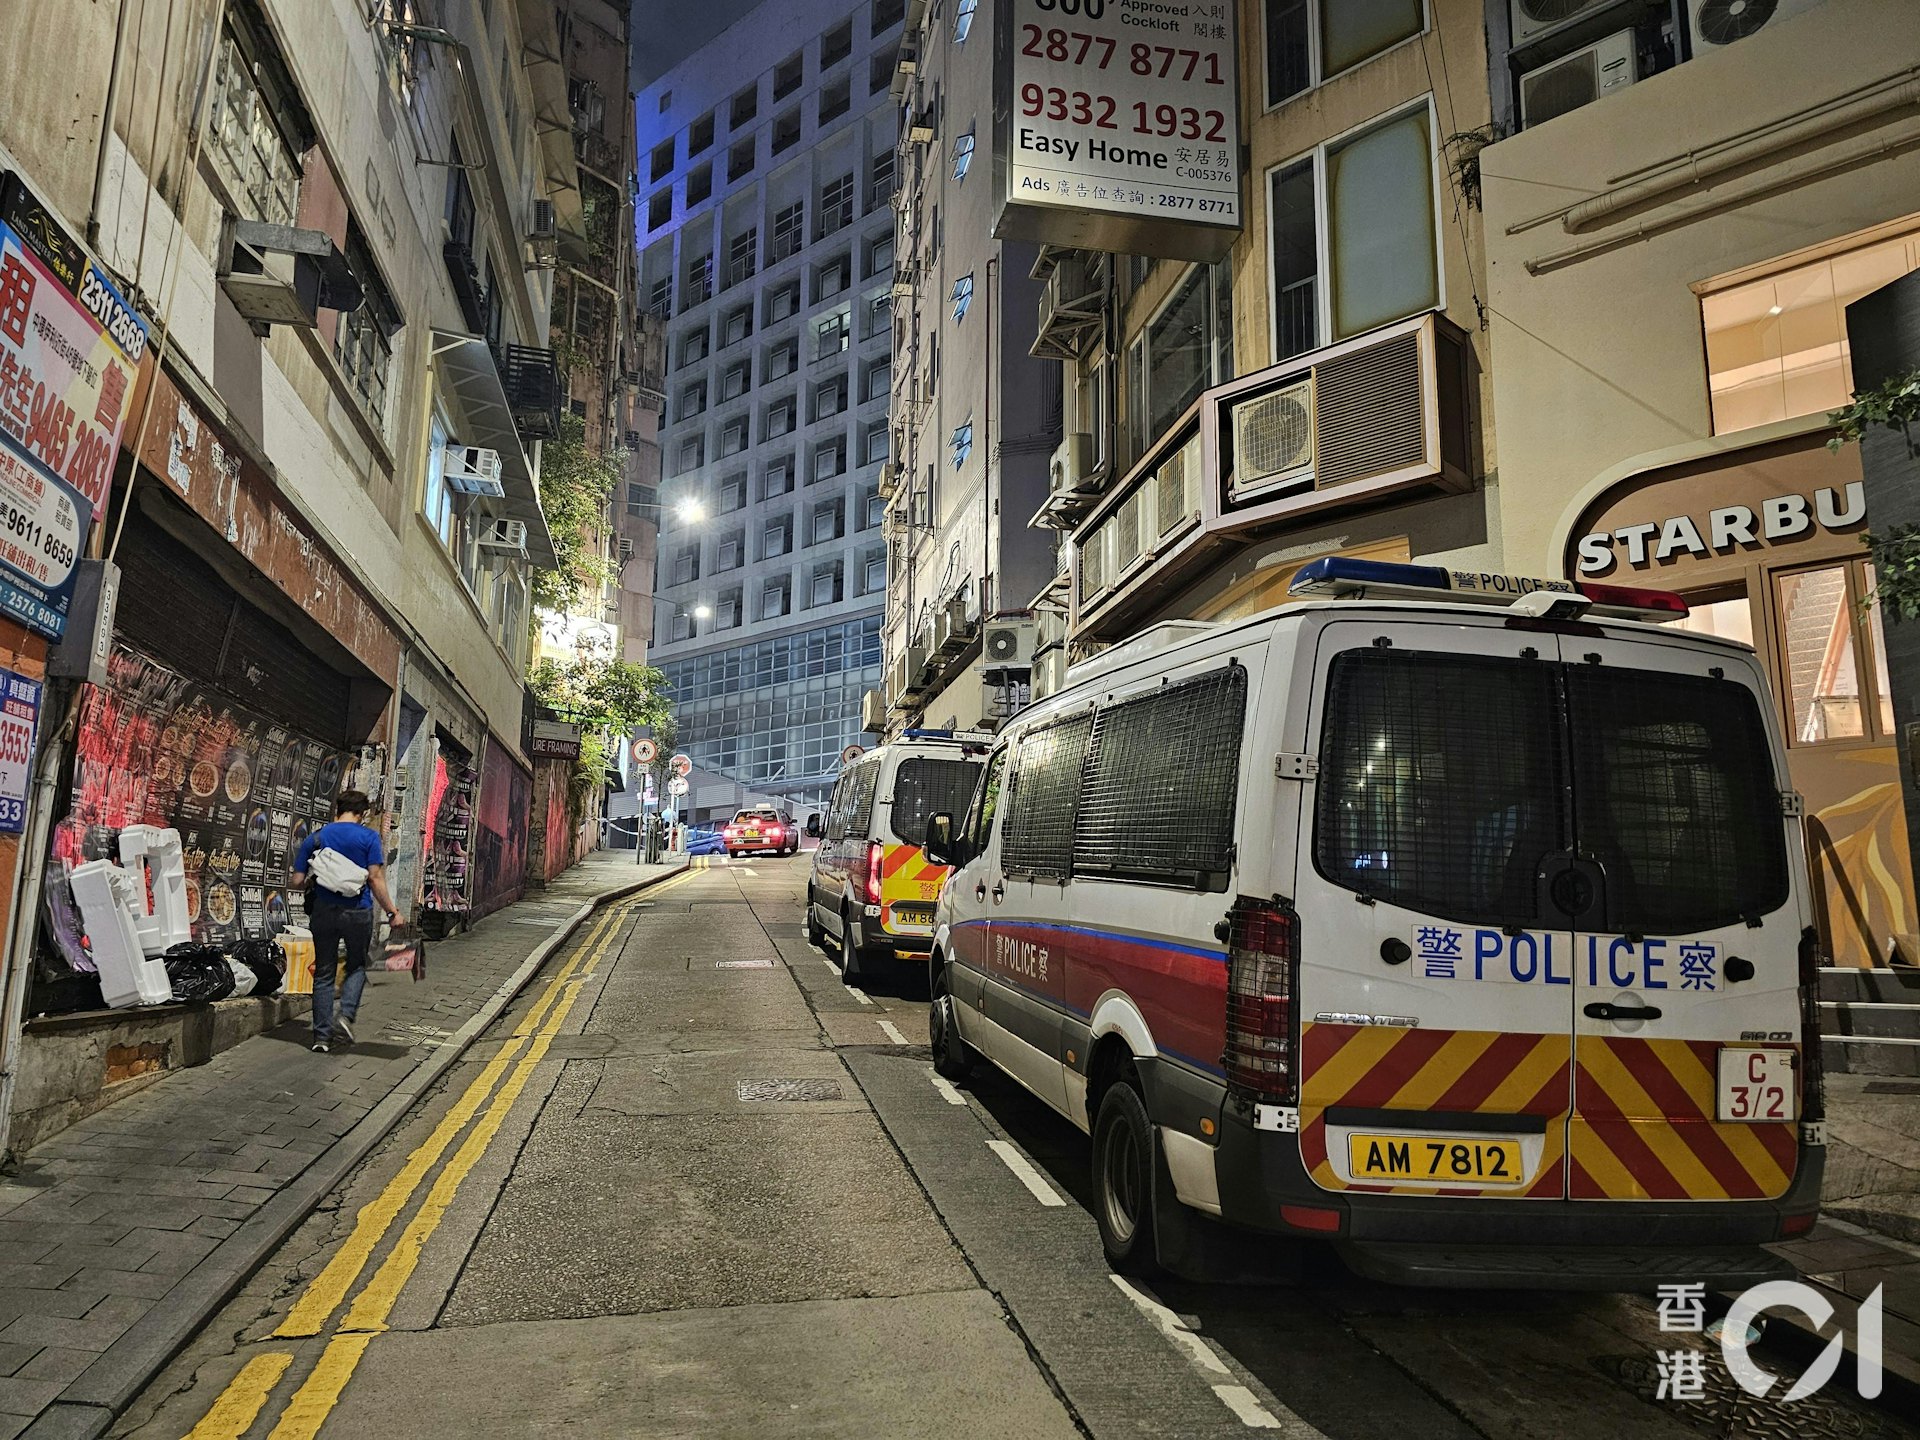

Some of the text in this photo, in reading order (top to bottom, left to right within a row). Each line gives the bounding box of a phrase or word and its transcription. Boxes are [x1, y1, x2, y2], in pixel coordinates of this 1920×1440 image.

[1121, 13, 1180, 32] Cockloft
[1192, 5, 1225, 20] 入則
[1193, 22, 1227, 40] 閣樓
[1021, 23, 1225, 85] 2877 8771
[1021, 83, 1227, 143] 9332 1932
[1020, 128, 1168, 170] Easy Home
[1174, 146, 1230, 168] 安居易
[1176, 166, 1232, 182] C-005376
[1021, 176, 1050, 192] Ads
[1055, 179, 1144, 205] 廣告位查詢
[1159, 193, 1194, 210] 2877
[1198, 197, 1235, 214] 8771
[11, 210, 28, 234] LAND
[80, 267, 116, 327] 2311
[109, 303, 146, 361] 2668
[94, 356, 129, 437] 售
[25, 381, 76, 472] 9465
[66, 420, 110, 504] 2083
[7, 508, 42, 547] 9611
[44, 533, 73, 569] 8659
[1452, 571, 1478, 589] 警
[1480, 573, 1544, 594] POLICE
[8, 591, 36, 616] 2576
[37, 607, 61, 631] 8081
[547, 742, 577, 756] FRAMING
[965, 733, 989, 742] POLICE
[919, 882, 935, 900] 警
[900, 912, 916, 923] AM
[1004, 936, 1037, 978] POLICE
[1038, 947, 1049, 983] 察
[1417, 926, 1717, 991] 警 POLICE 察
[1313, 1011, 1420, 1028] SPRINTER
[1748, 1053, 1767, 1084] C
[1730, 1086, 1785, 1118] 3/2
[1365, 1141, 1509, 1177] AM 7812
